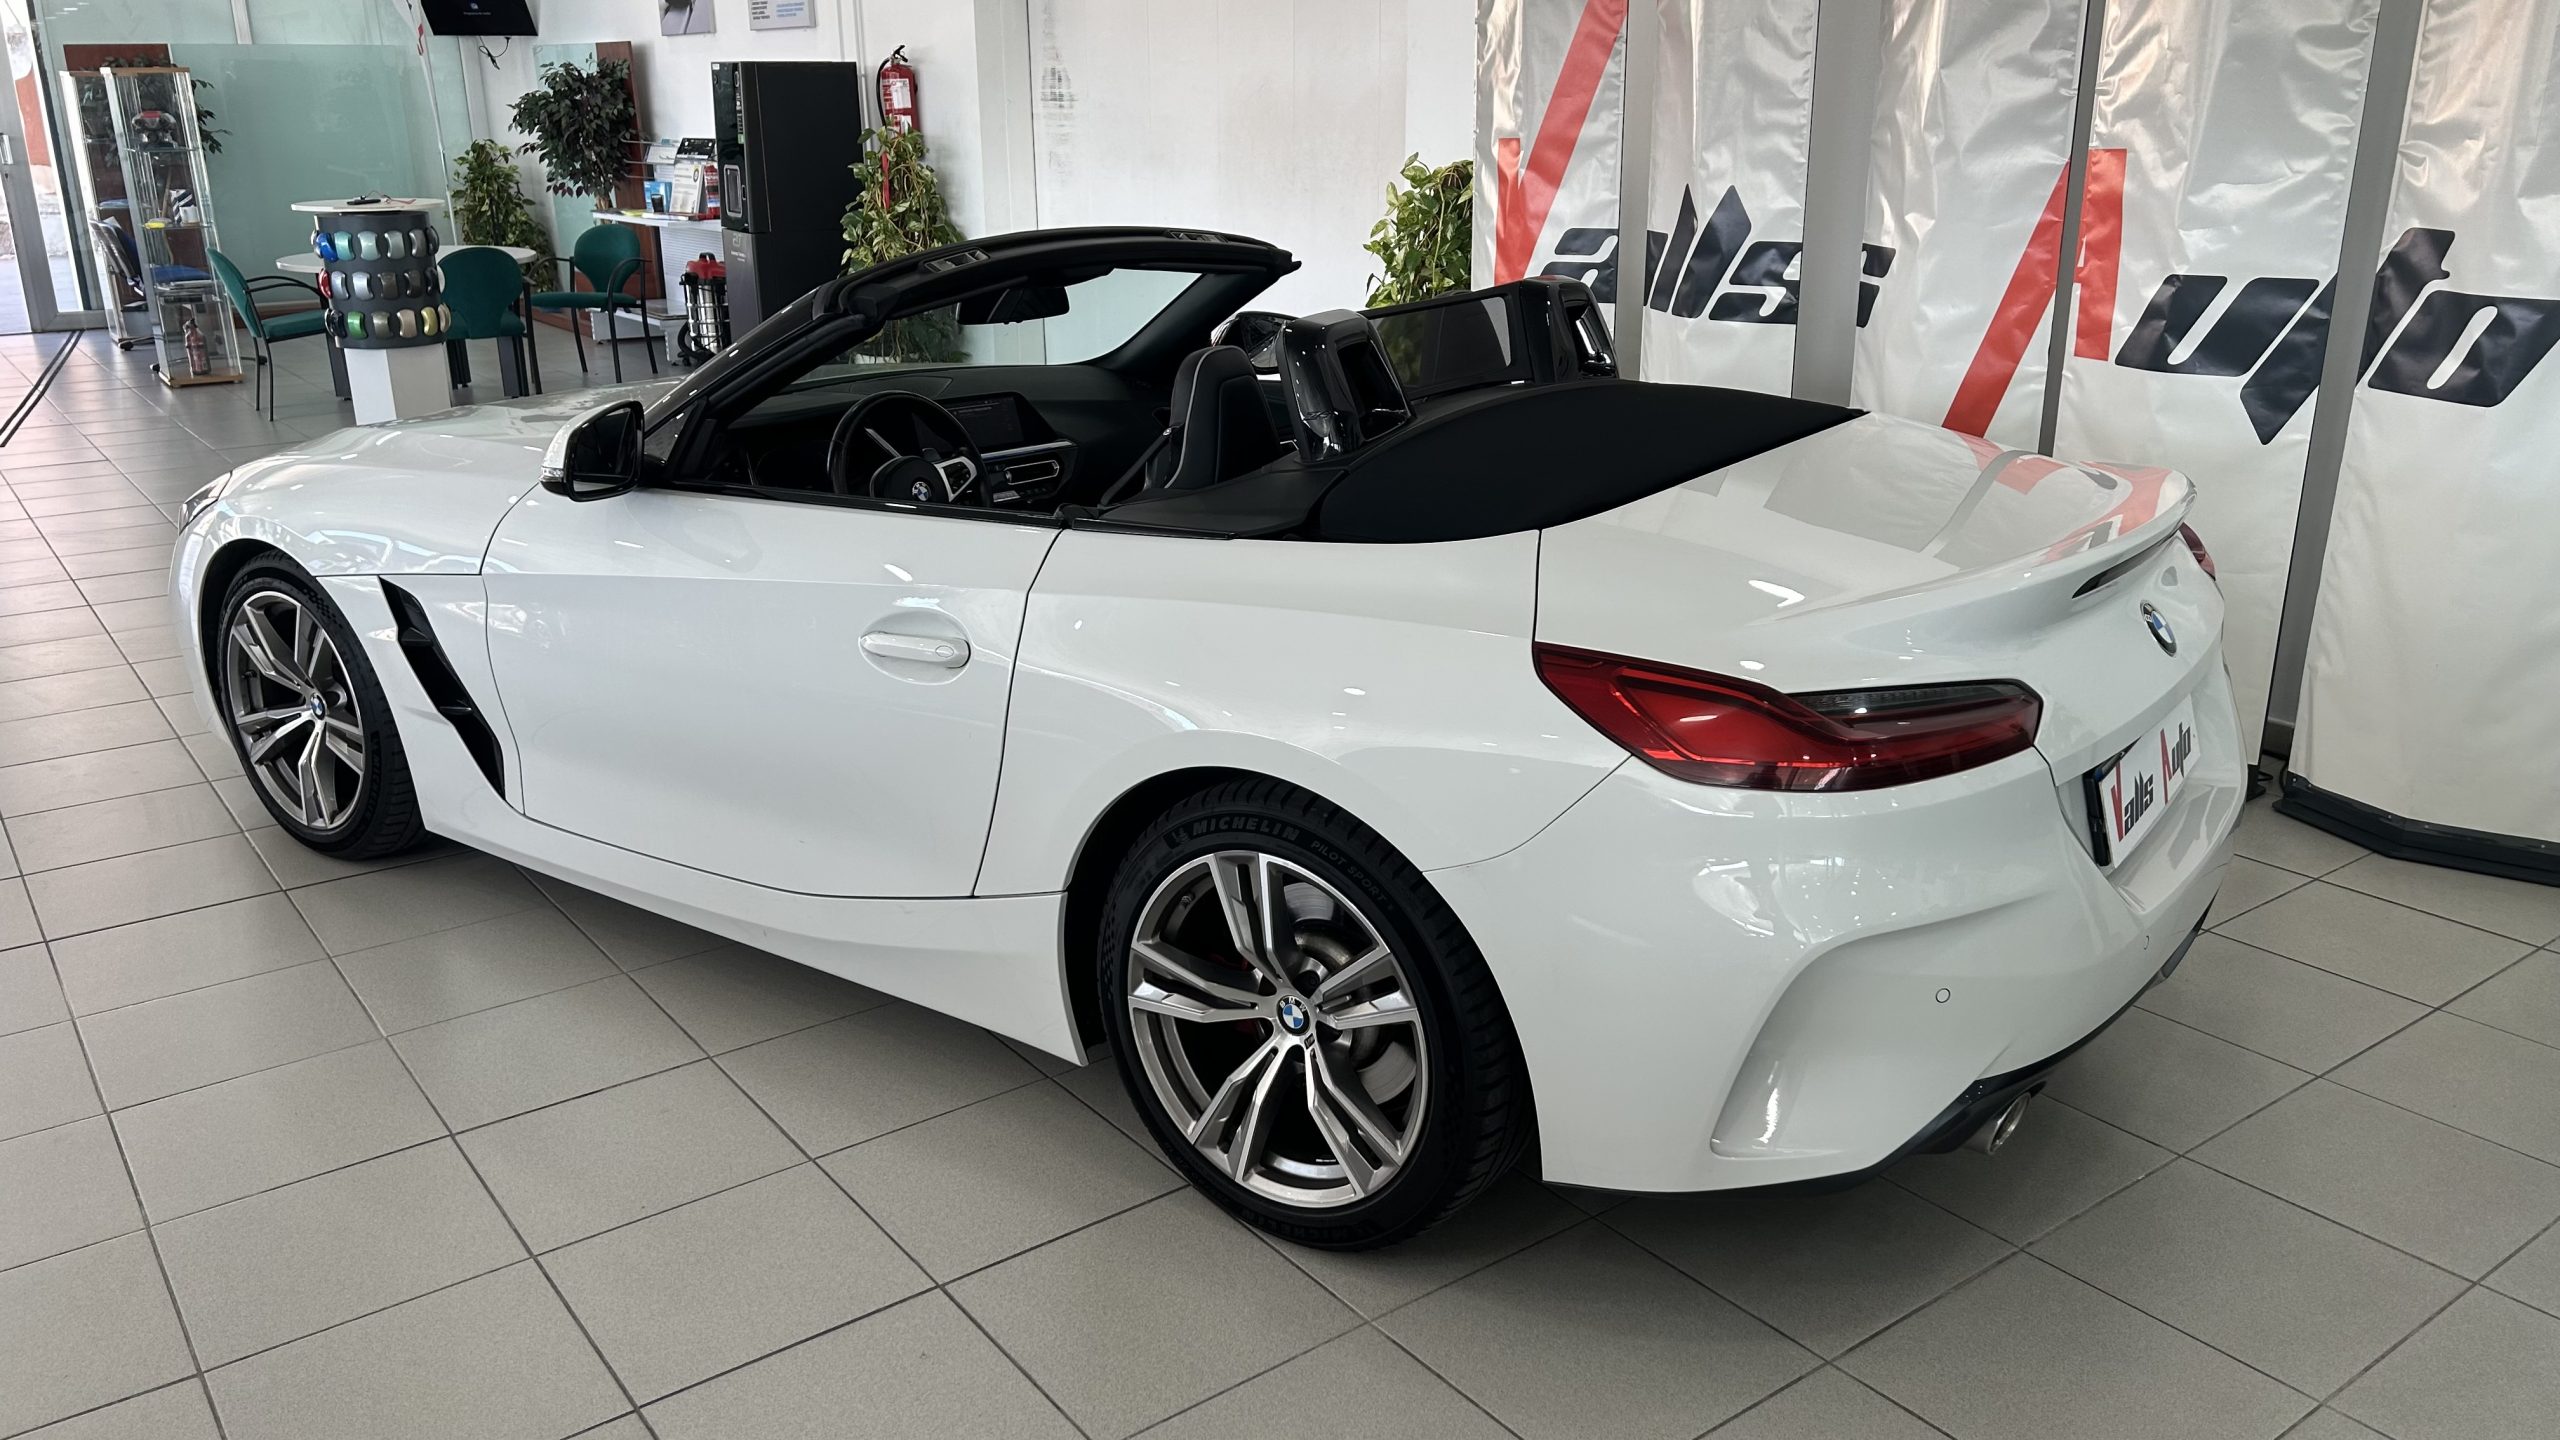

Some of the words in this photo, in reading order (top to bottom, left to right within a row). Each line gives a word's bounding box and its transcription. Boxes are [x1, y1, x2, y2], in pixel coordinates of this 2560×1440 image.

[1941, 148, 2560, 446] Auto
[2111, 759, 2154, 842] Valls
[2160, 722, 2191, 805] Auto
[1192, 816, 1301, 842] MICHELIN
[1310, 840, 1347, 865] PILOT
[1347, 866, 1386, 901] SPORT
